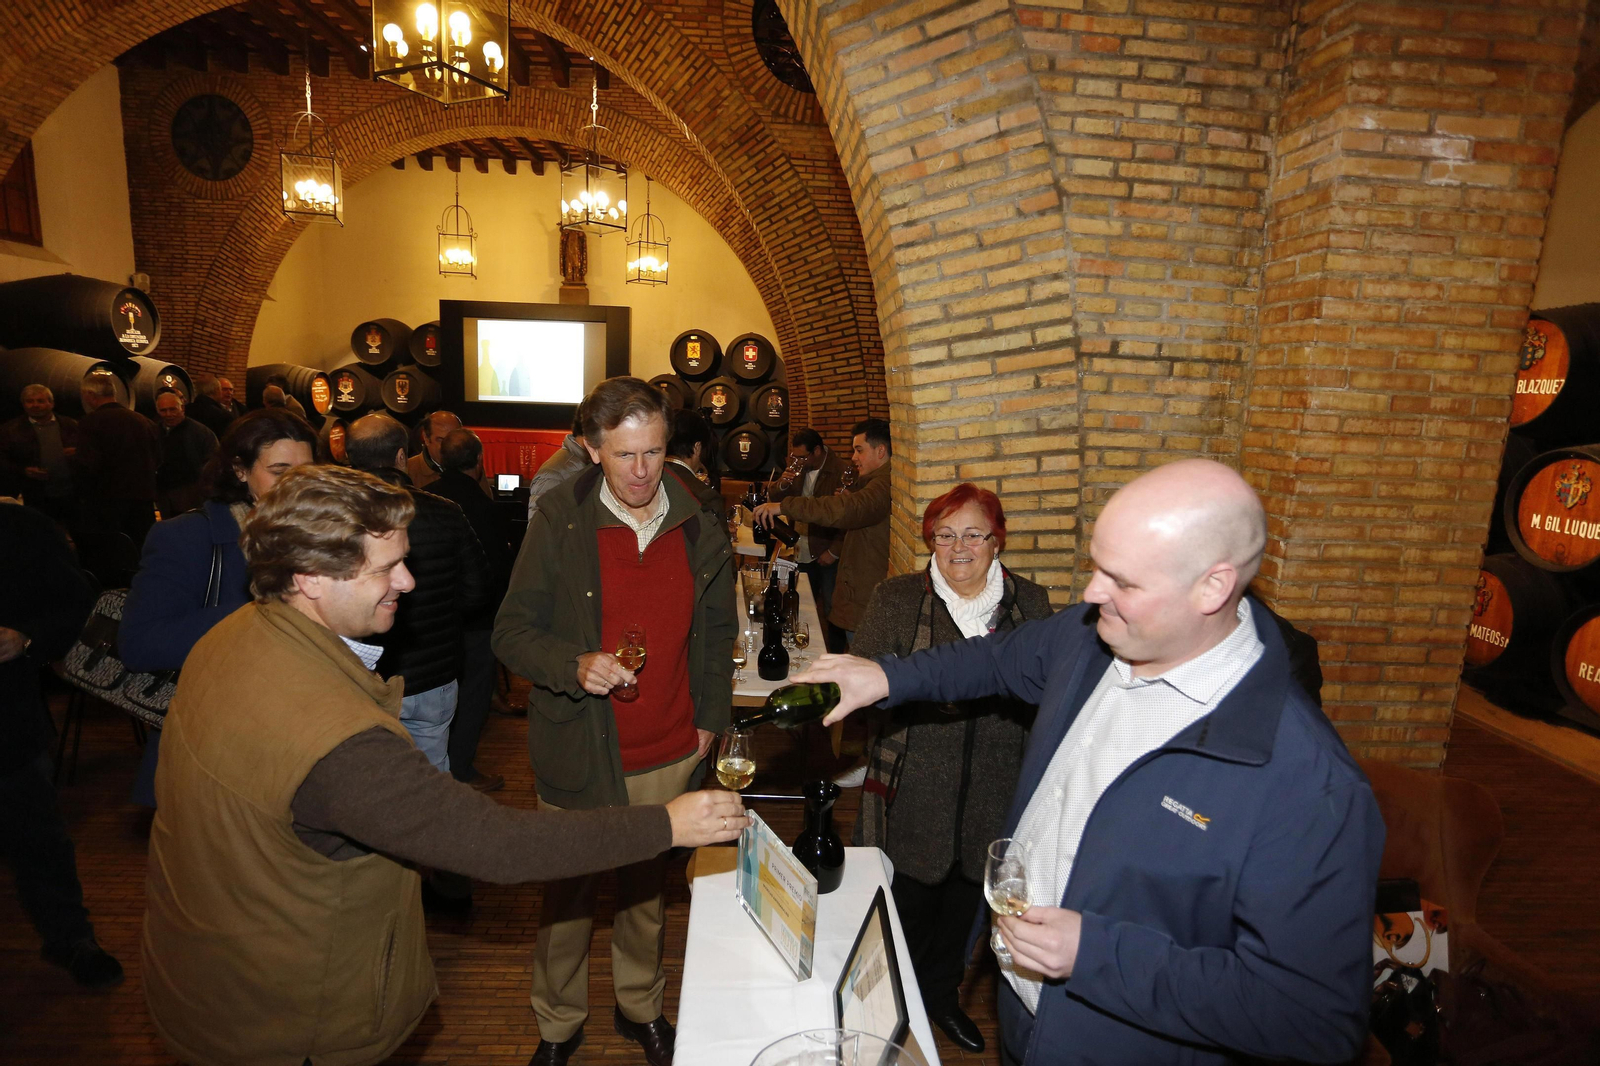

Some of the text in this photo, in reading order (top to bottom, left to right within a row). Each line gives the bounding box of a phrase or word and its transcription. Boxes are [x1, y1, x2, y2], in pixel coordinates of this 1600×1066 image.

[1516, 379, 1565, 394] BLAZQUEZ
[1545, 515, 1561, 533] GIL
[1564, 518, 1600, 540] LUQUE
[1469, 623, 1502, 646] MATEOS
[1163, 795, 1193, 817] REGATTA
[771, 862, 786, 882] PRIMER
[787, 880, 803, 902] PREMIO
